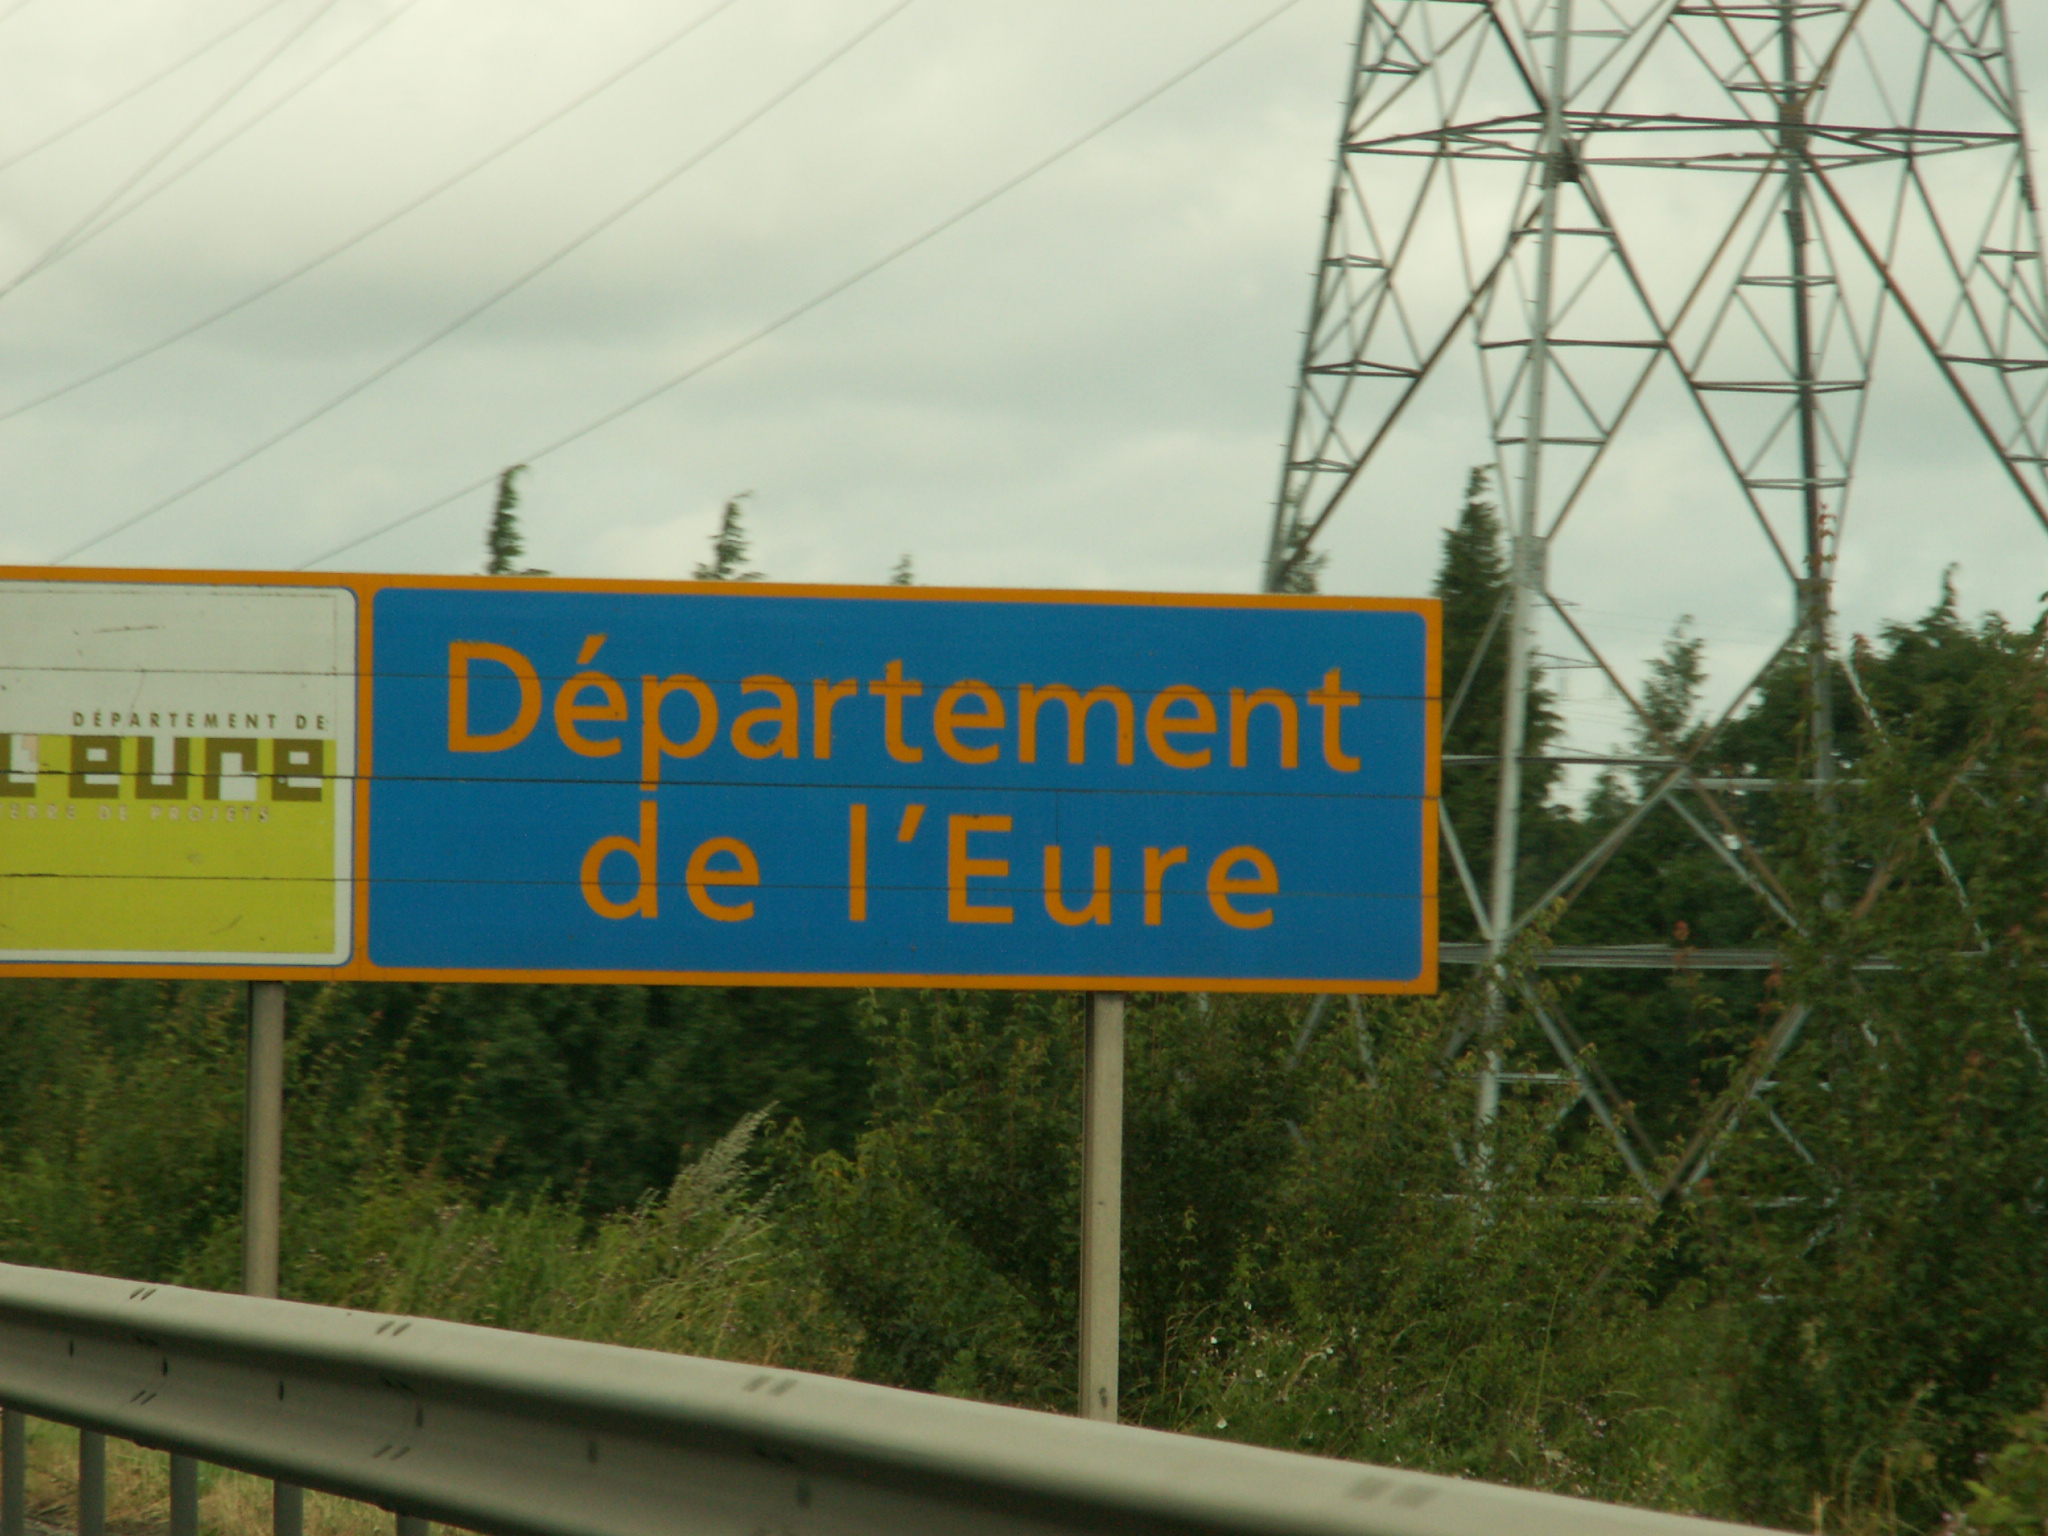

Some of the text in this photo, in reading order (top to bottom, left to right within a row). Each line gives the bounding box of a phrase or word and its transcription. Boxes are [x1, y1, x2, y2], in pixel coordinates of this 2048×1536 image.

[296, 715, 326, 731] DE
[447, 633, 1362, 791] Département
[98, 803, 129, 822] DE
[150, 806, 271, 823] PROJETS
[580, 799, 761, 923] de
